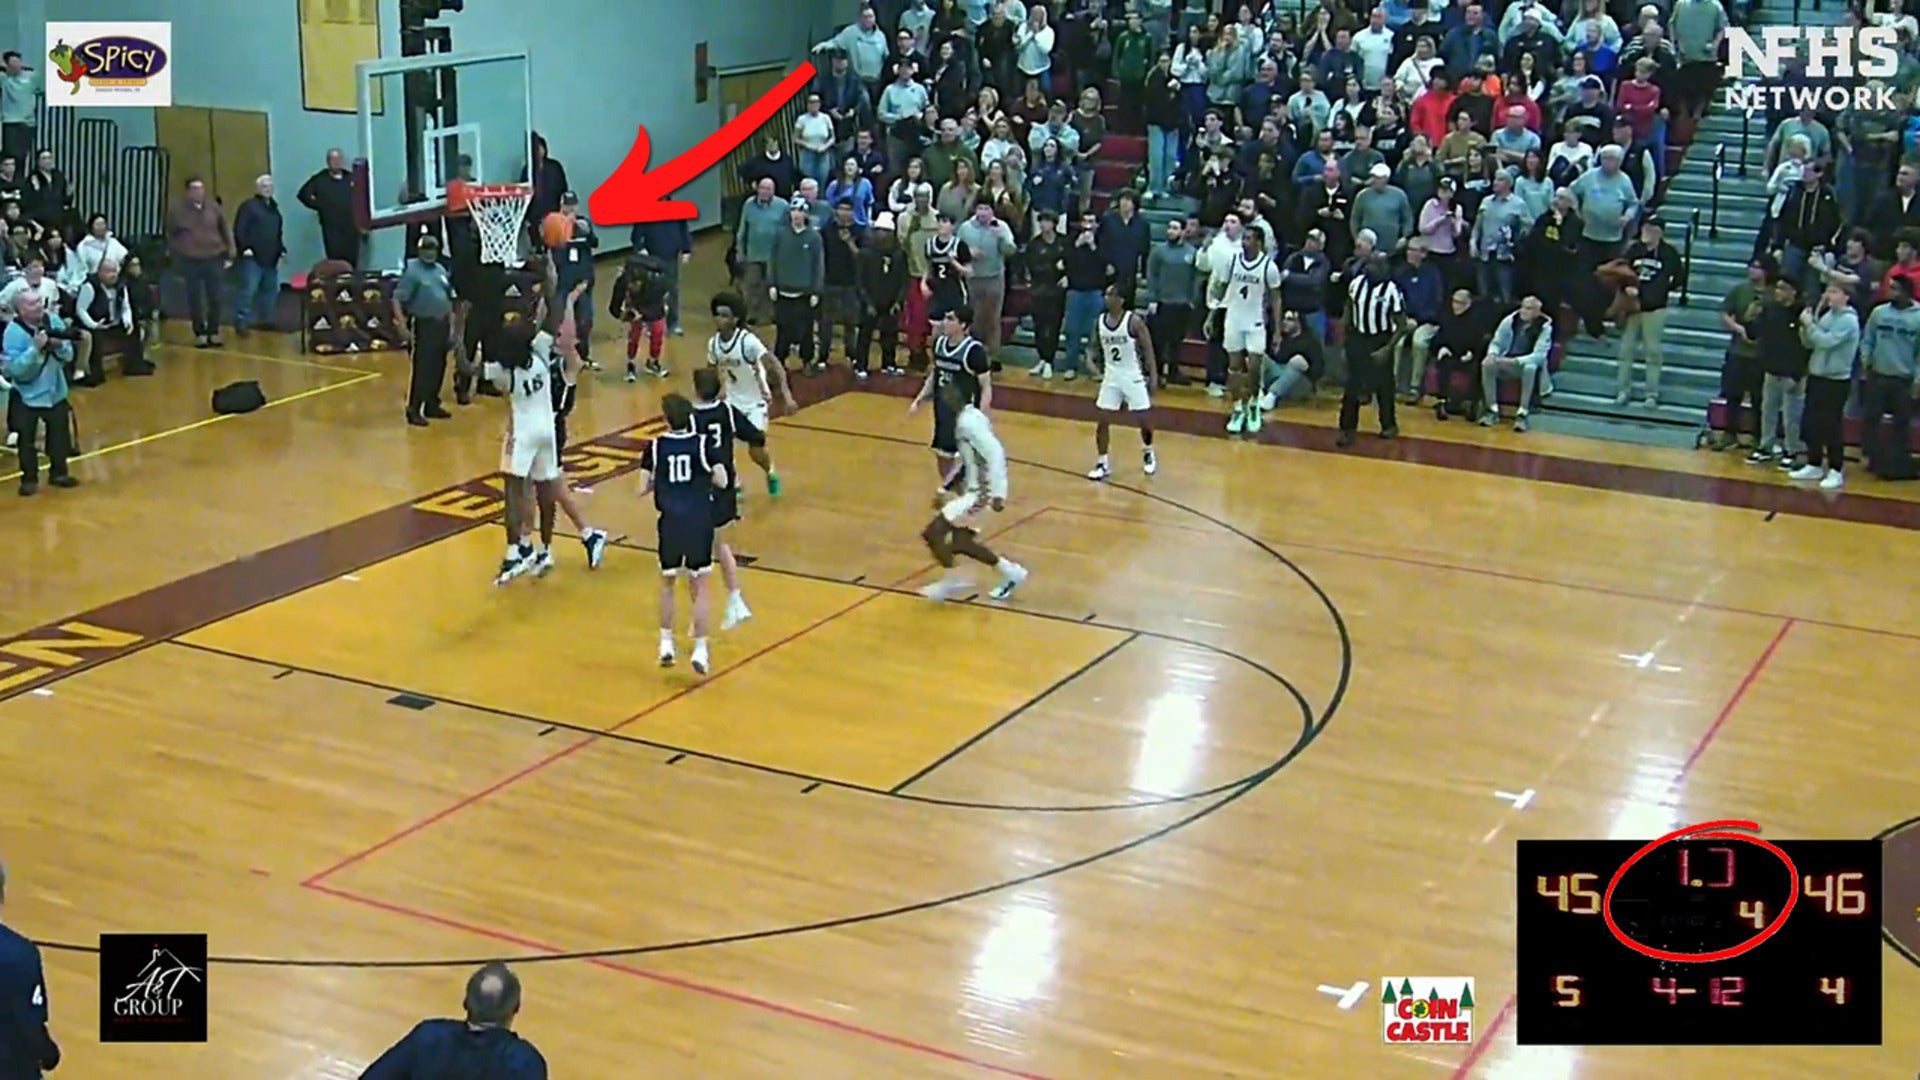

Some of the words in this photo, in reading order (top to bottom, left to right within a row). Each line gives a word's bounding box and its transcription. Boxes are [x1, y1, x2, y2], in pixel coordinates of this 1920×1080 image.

[1239, 285, 1249, 300] 4
[1111, 347, 1121, 361] 2
[708, 423, 722, 448] 3
[668, 454, 691, 483] 10
